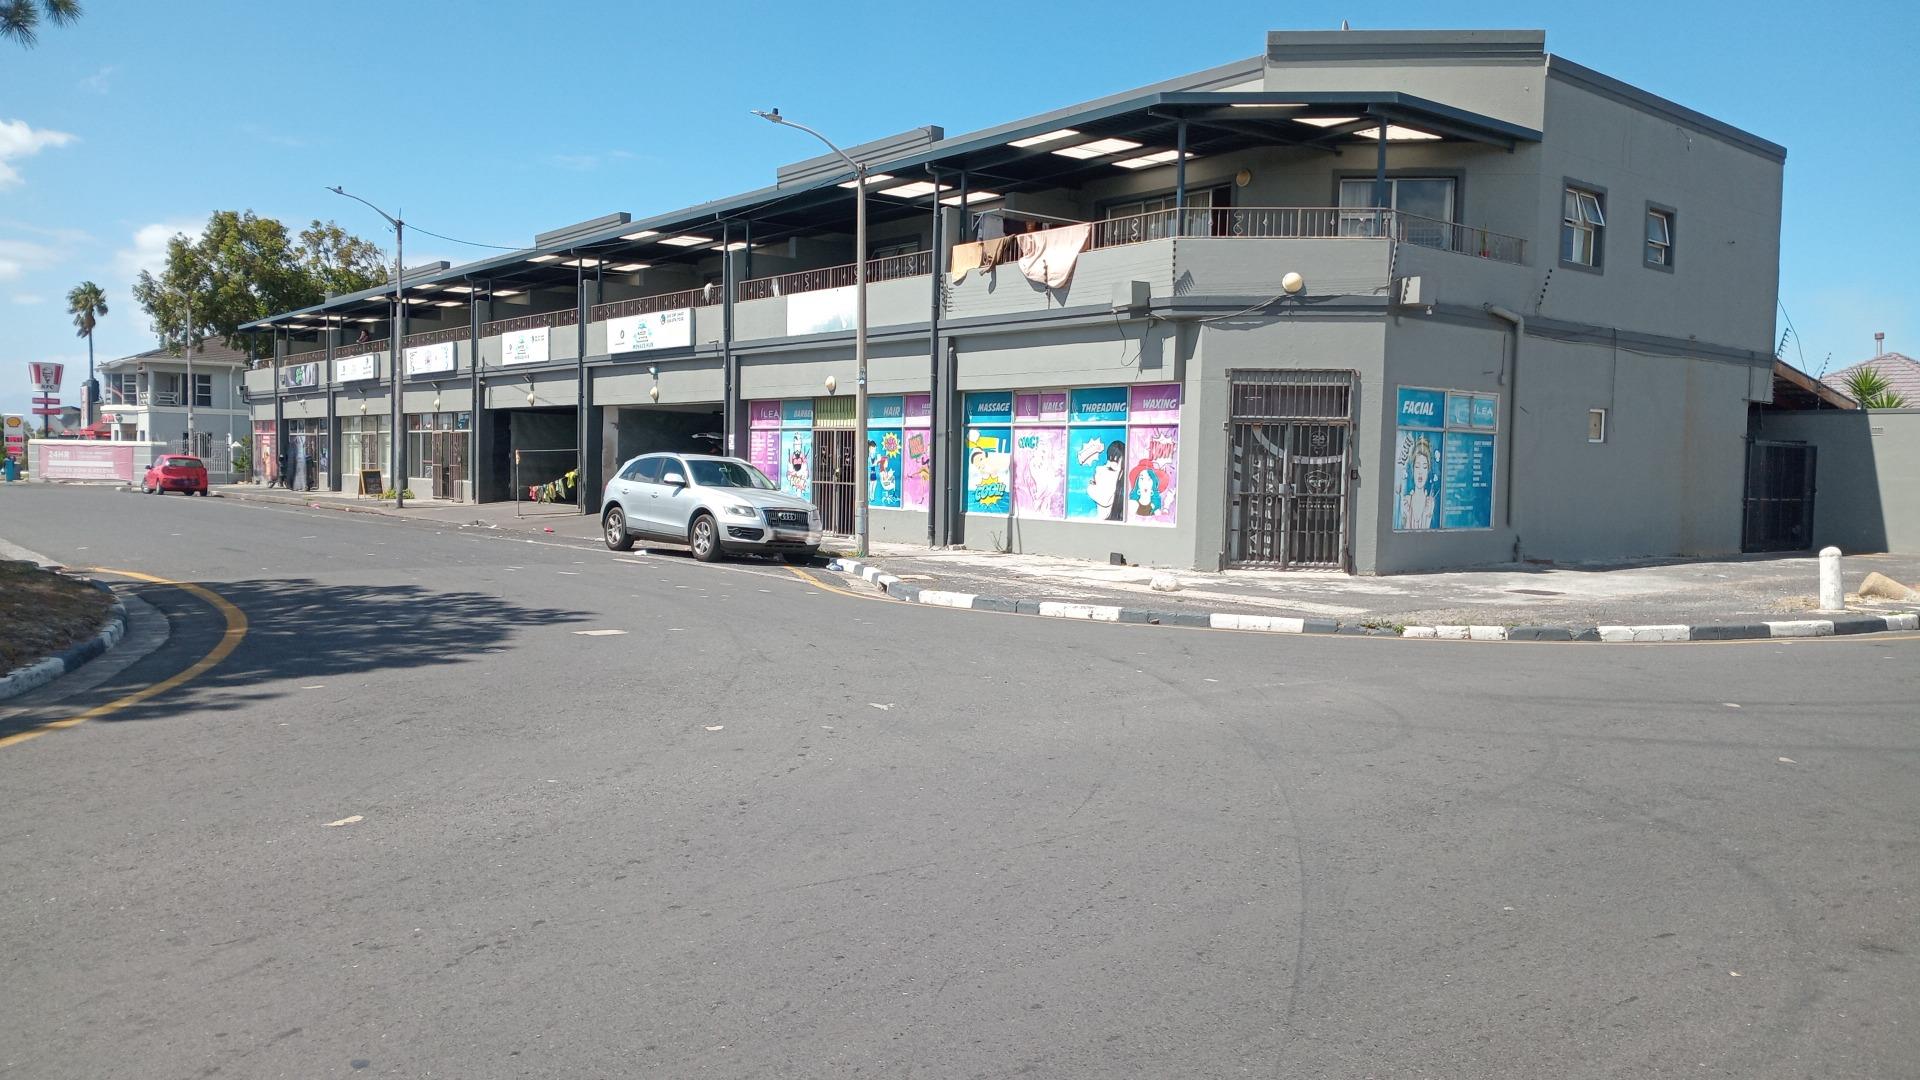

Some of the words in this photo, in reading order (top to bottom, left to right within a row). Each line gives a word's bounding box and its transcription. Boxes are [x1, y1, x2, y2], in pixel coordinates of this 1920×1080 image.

[977, 402, 1010, 412] MASSAGE
[1042, 402, 1064, 411] NAILS
[1081, 402, 1126, 413] THREADING
[1142, 399, 1177, 409] WAXING
[1402, 401, 1434, 416] FACIAL
[884, 406, 900, 417] HAIR
[1263, 457, 1275, 558] RESPONSE
